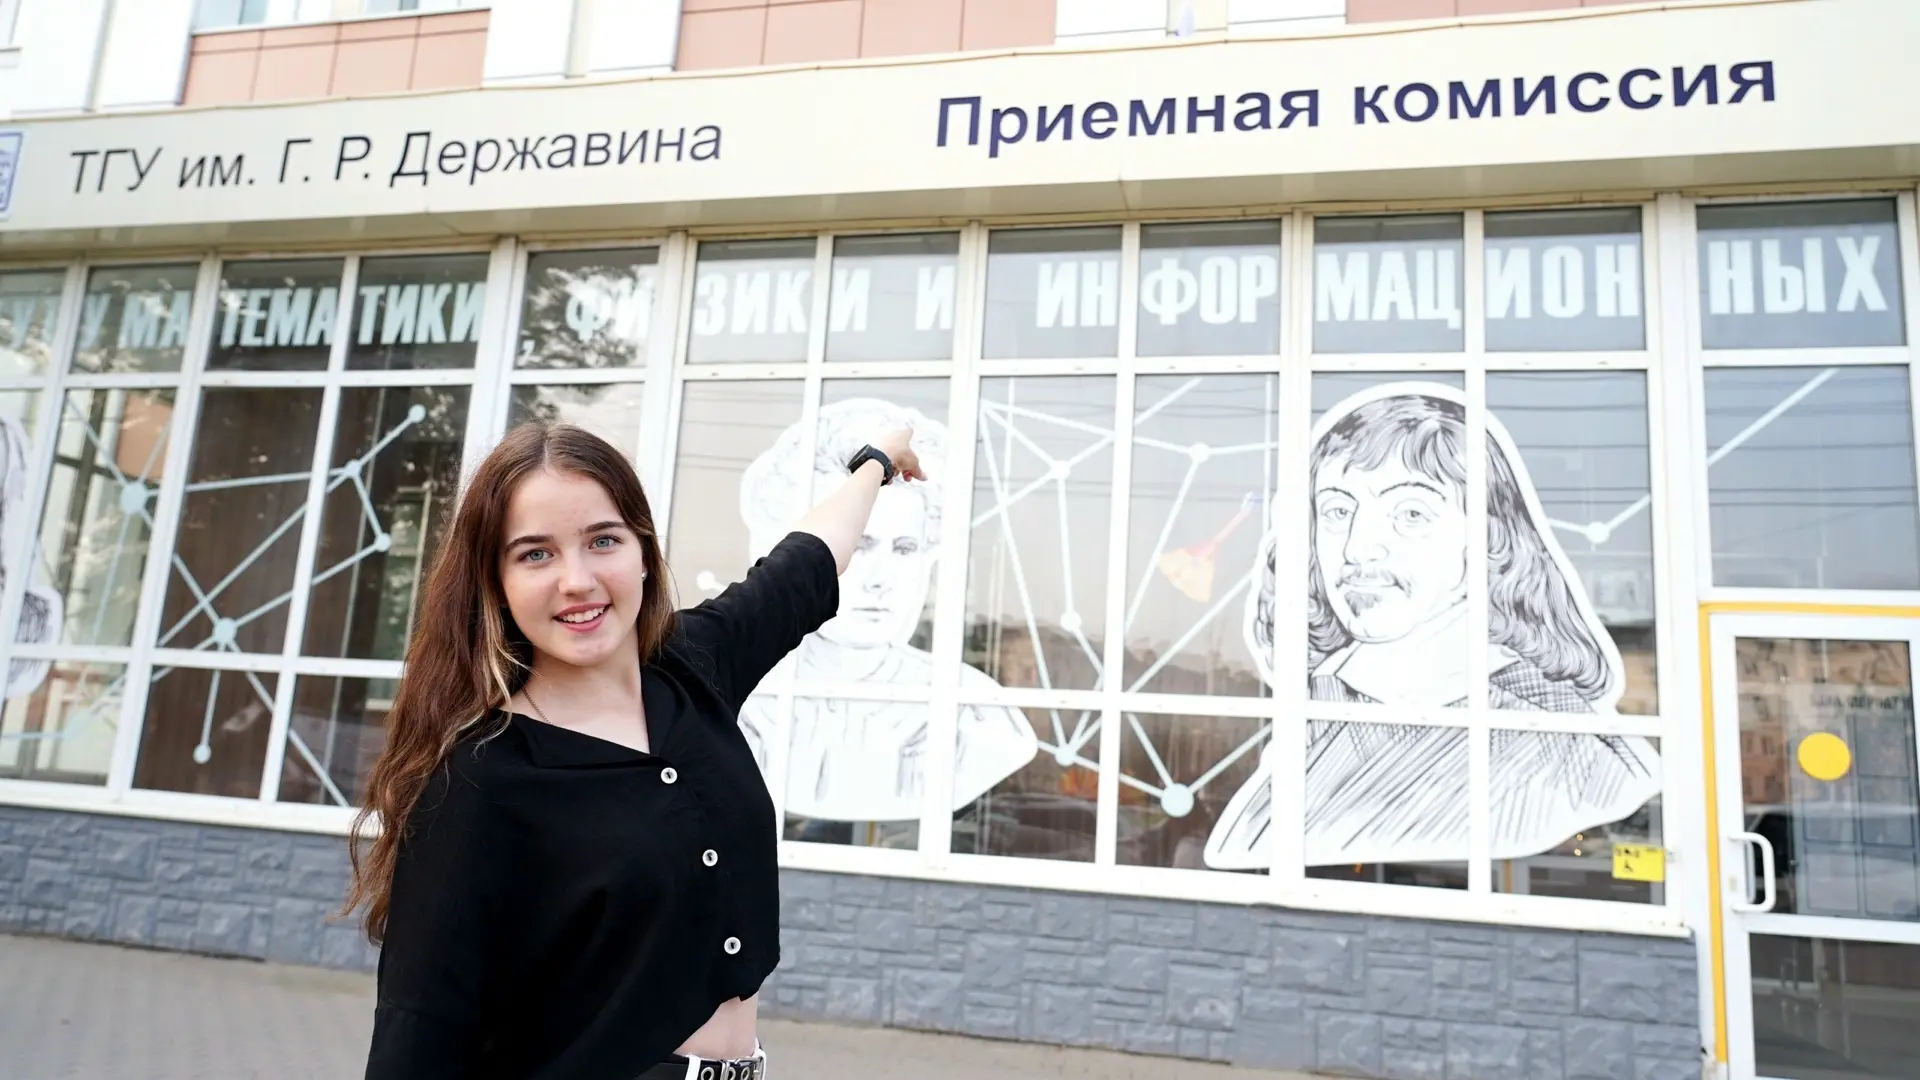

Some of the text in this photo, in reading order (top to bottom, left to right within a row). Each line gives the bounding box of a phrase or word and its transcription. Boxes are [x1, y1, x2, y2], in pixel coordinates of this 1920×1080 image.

[936, 60, 1777, 159] Приемная комиссия
[71, 124, 722, 194] ТГУ им. Г. Р. Державина
[914, 264, 956, 331] И
